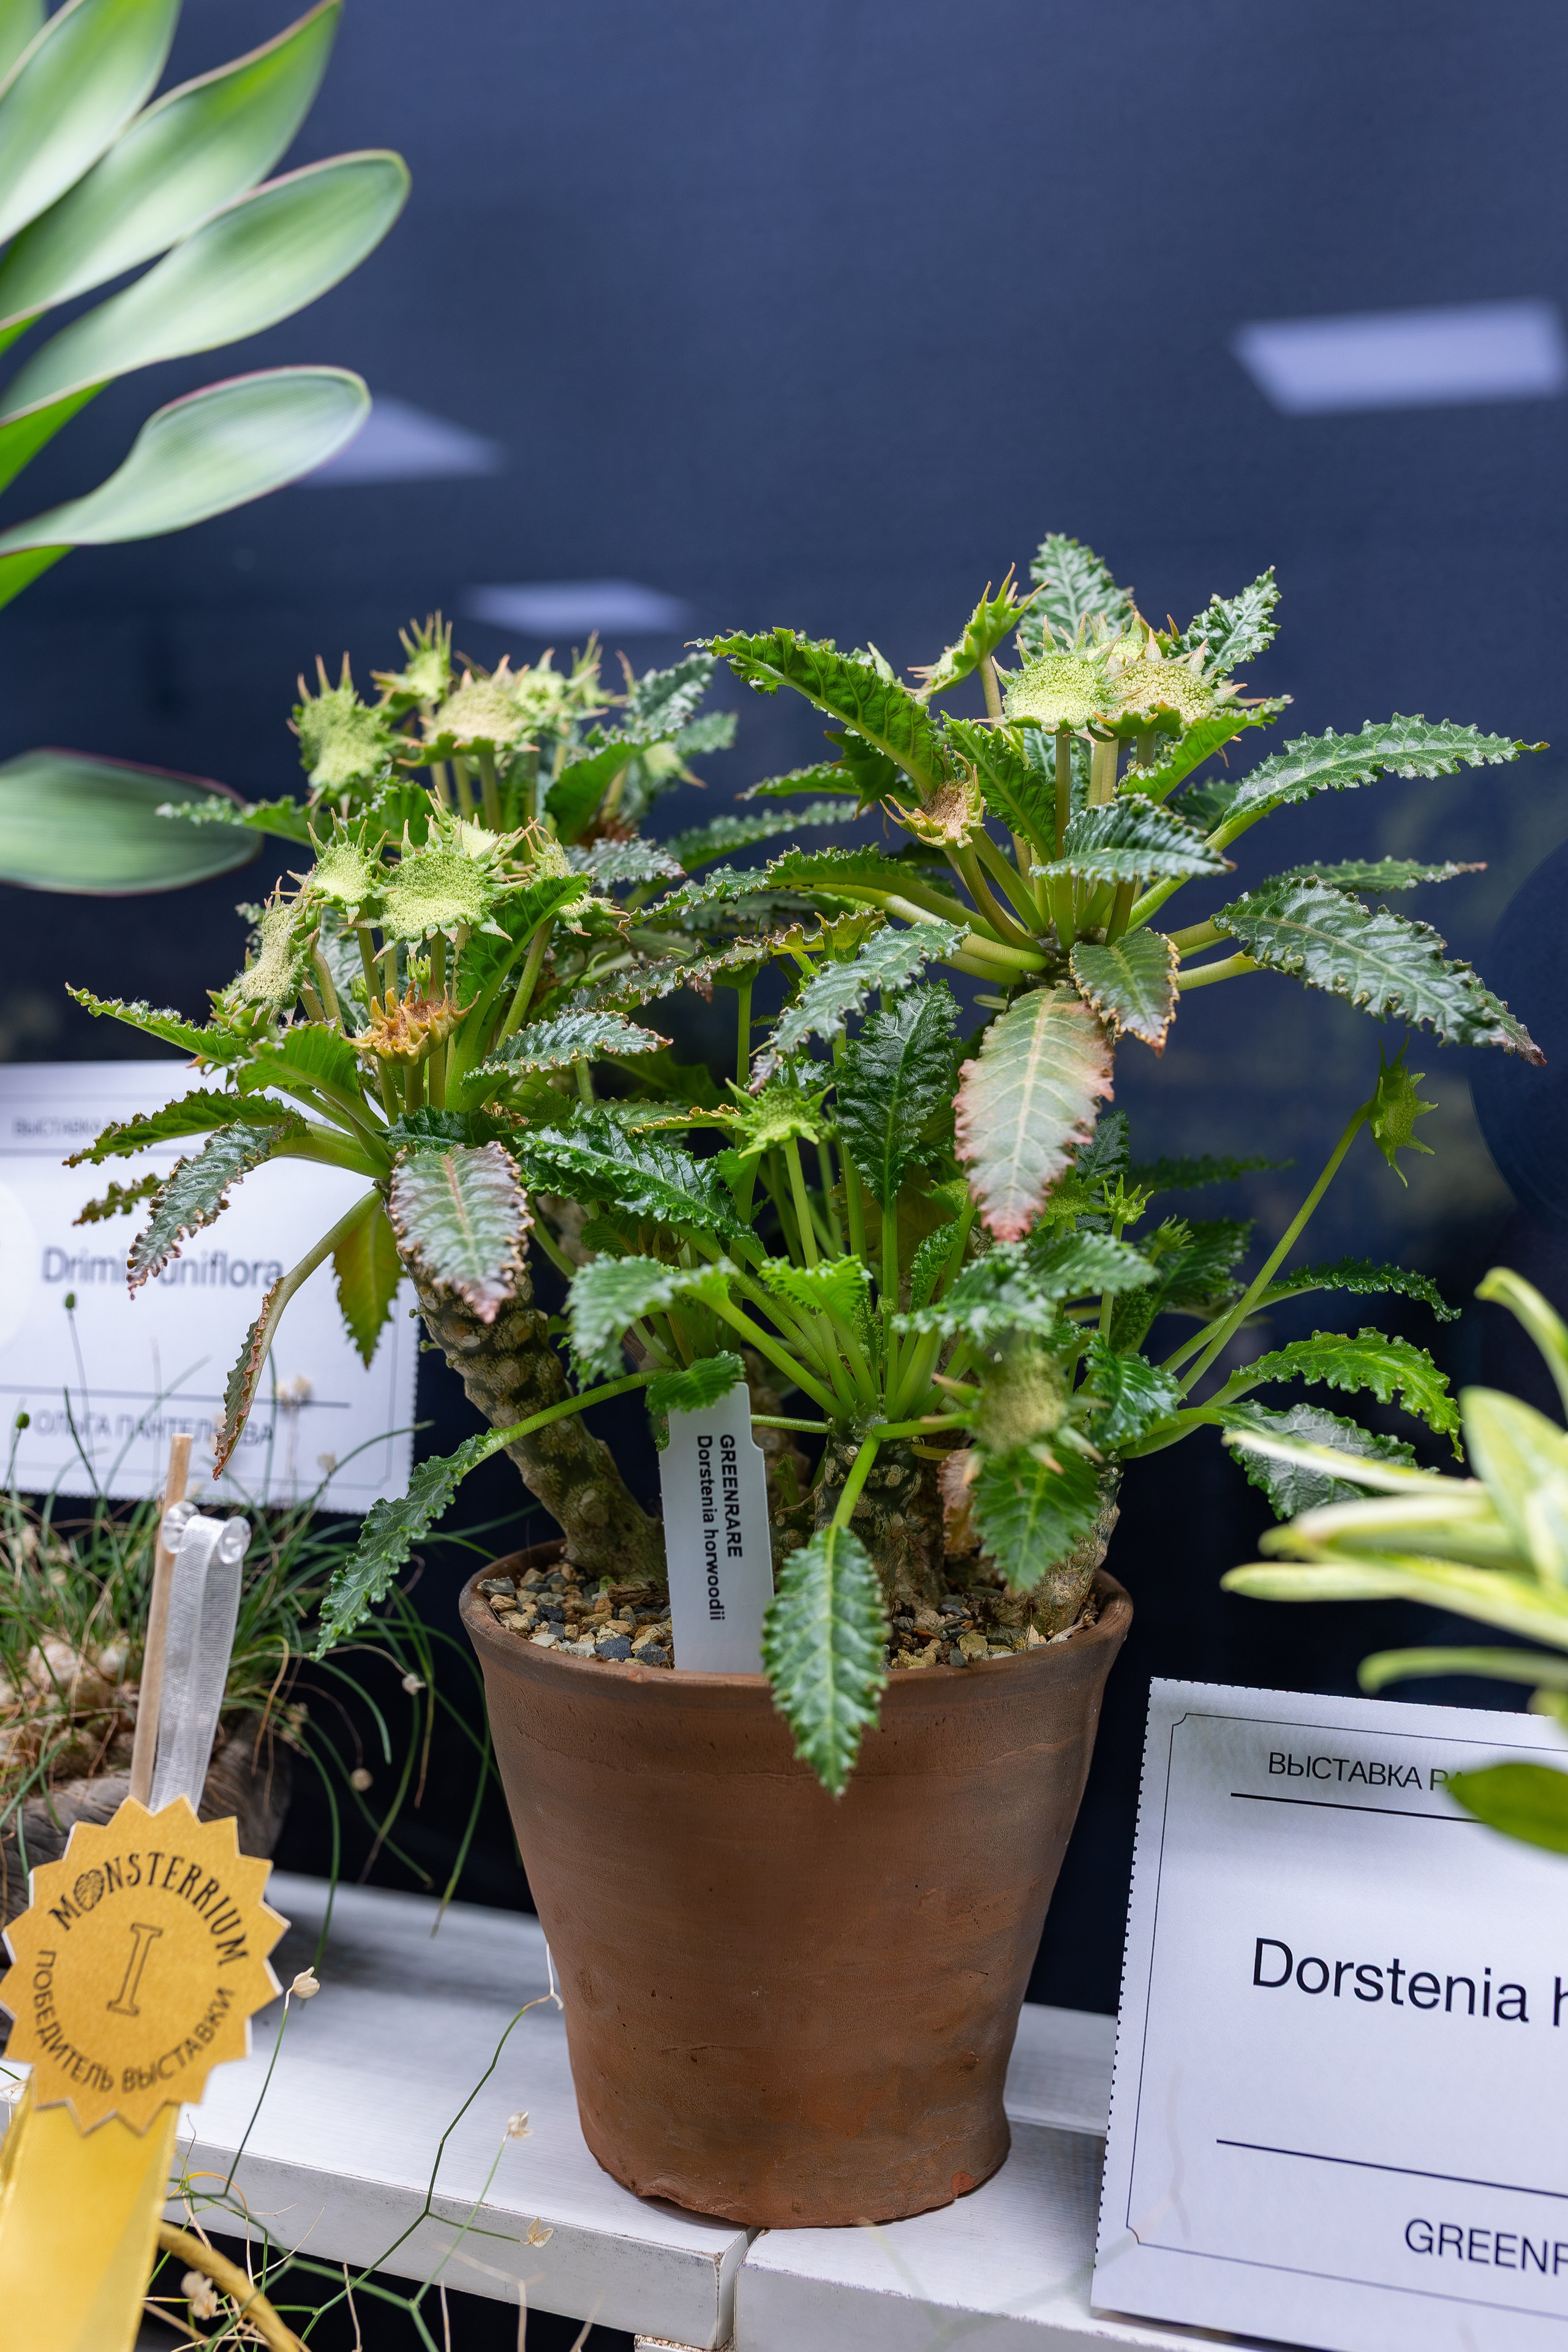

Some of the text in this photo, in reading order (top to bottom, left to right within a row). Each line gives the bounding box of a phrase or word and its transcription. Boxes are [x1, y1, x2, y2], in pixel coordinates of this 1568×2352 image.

[159, 1250, 282, 1287] uniflora
[697, 1434, 725, 1621] Dorstenia horwoodii
[719, 1434, 743, 1558] GREENRARE
[1268, 1751, 1423, 1790] ВЫСТАВКА
[48, 1851, 249, 1967] MONSTERRIUM
[32, 1949, 236, 2094] ПОБЕДИТЕЛЬ ВЫСТАВКИ
[1253, 1937, 1530, 2023] Dorstenia
